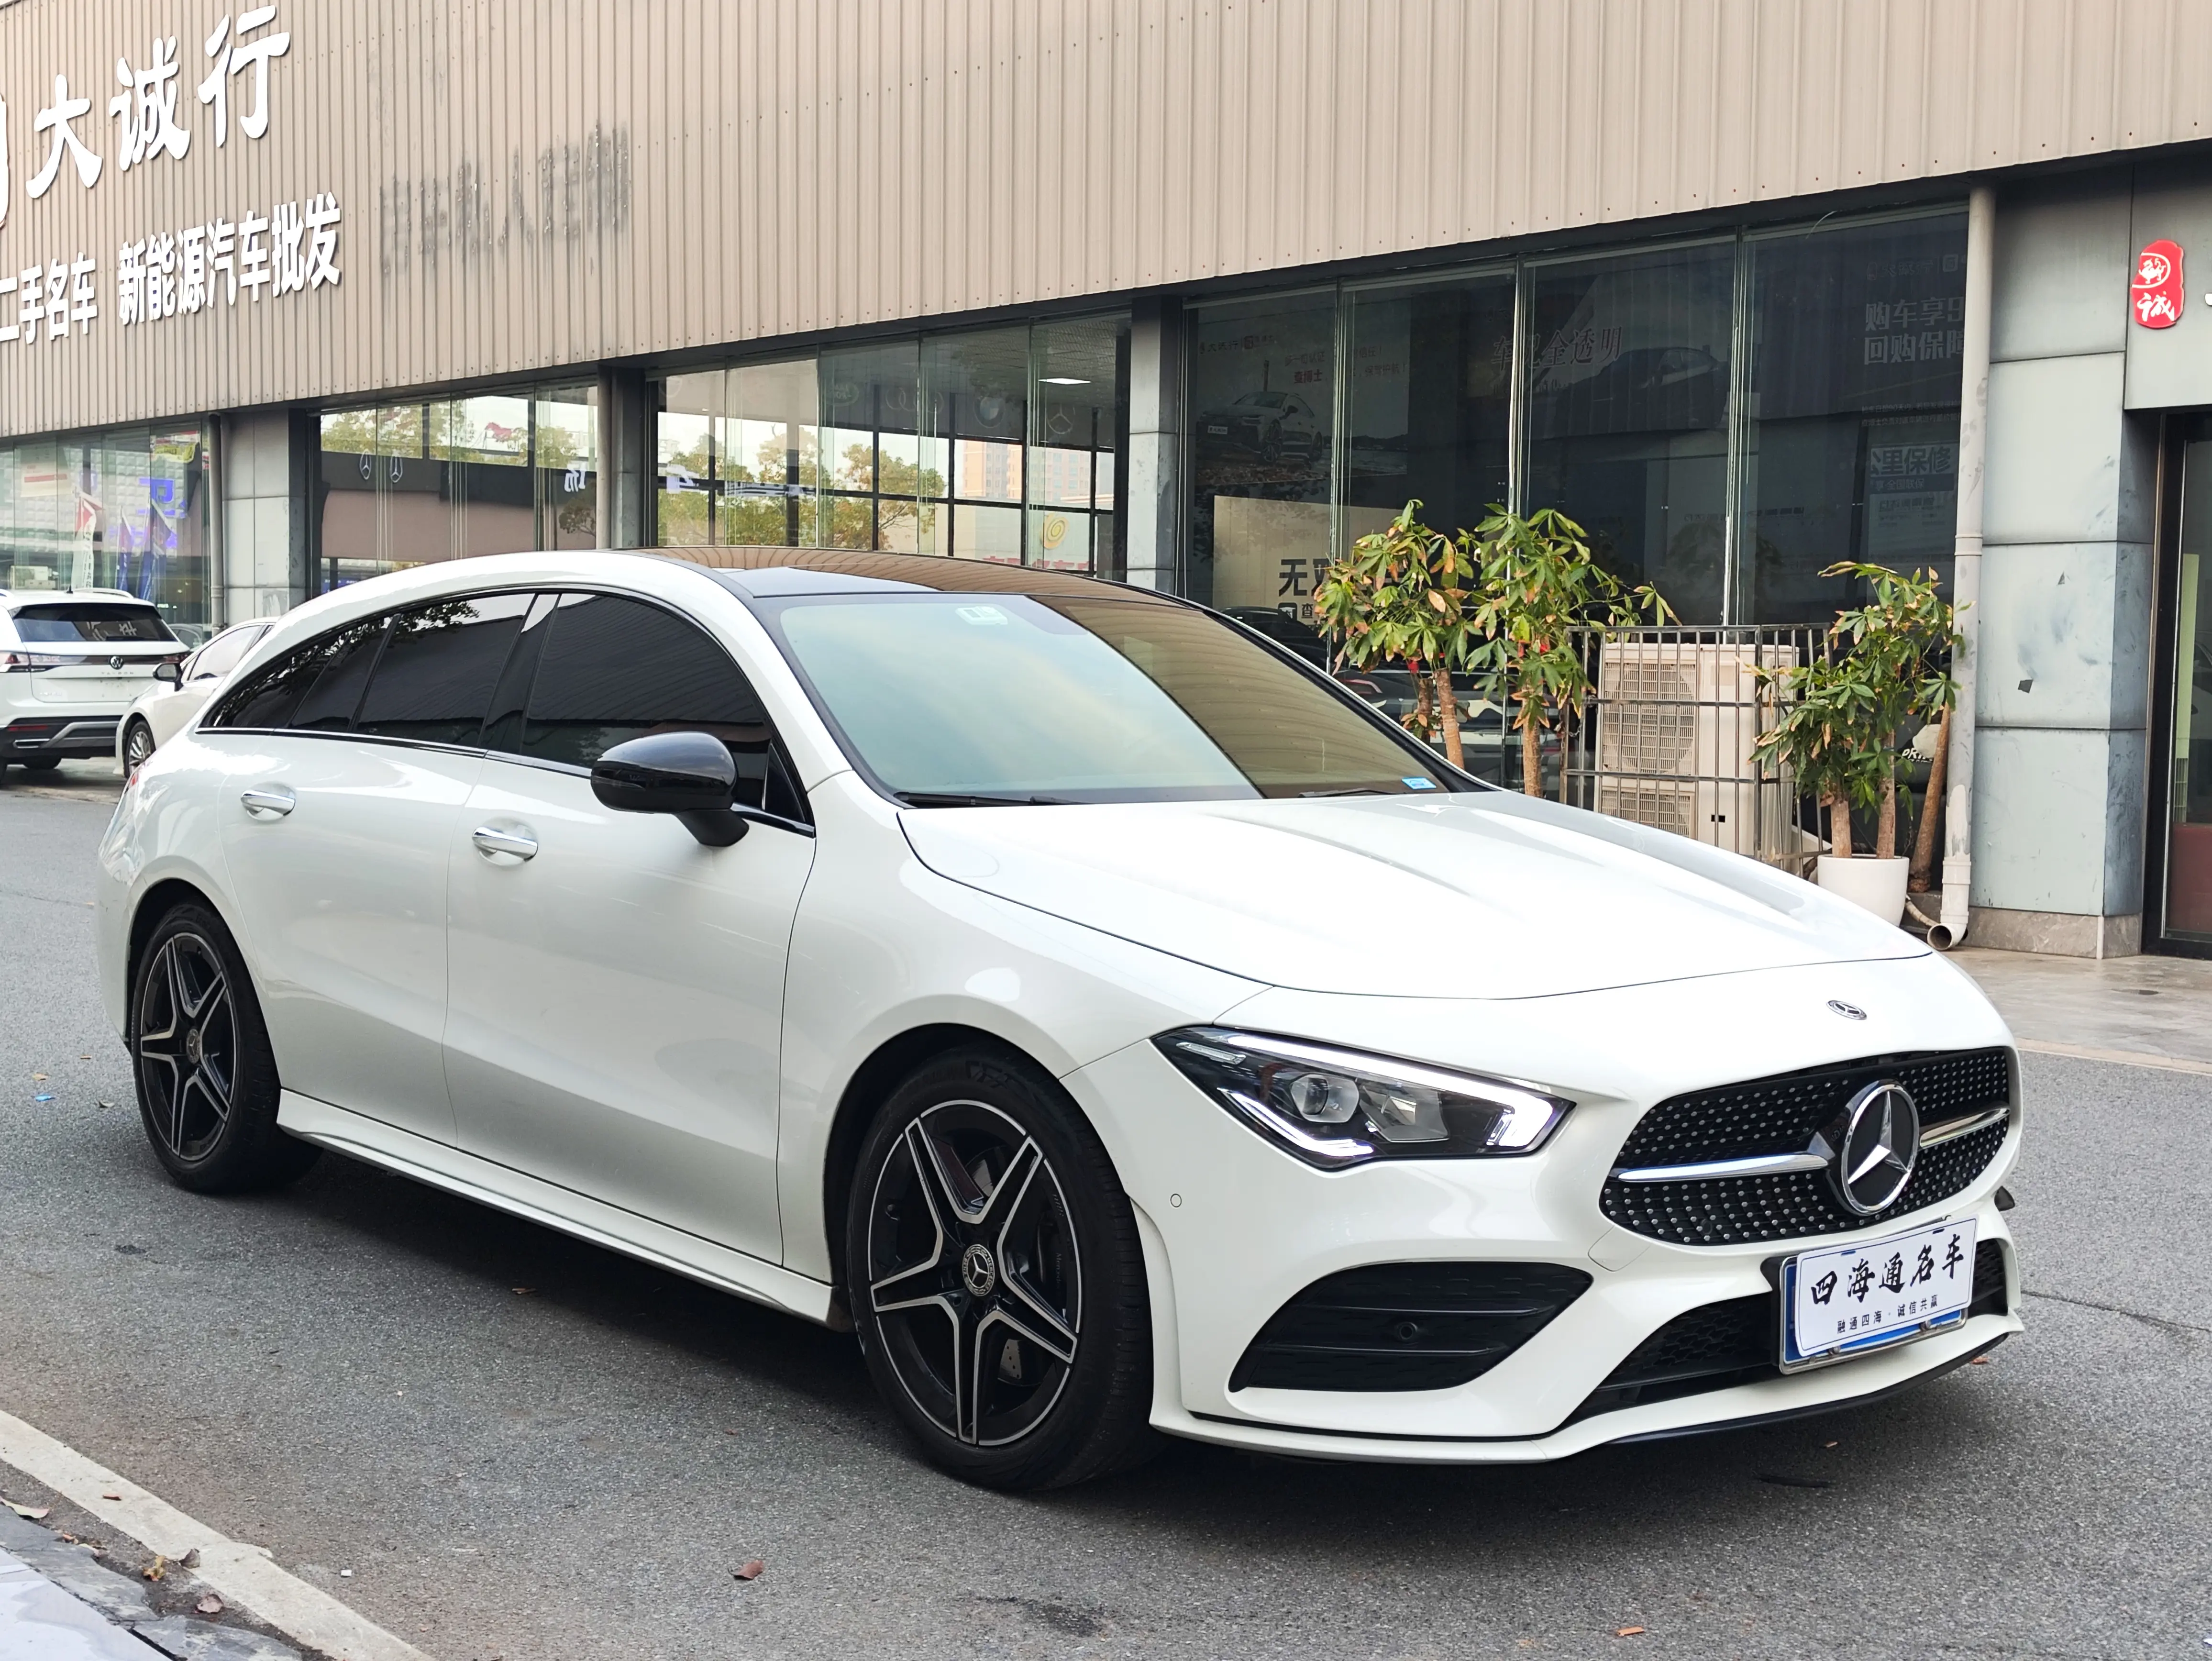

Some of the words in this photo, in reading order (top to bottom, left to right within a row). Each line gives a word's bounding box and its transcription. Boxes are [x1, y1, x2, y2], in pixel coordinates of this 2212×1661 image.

[26, 5, 290, 199] 大诚行
[0, 252, 98, 344] 二手名车
[118, 191, 342, 325] 新能源汽车批发
[1811, 1233, 1965, 1305] 四海通名车
